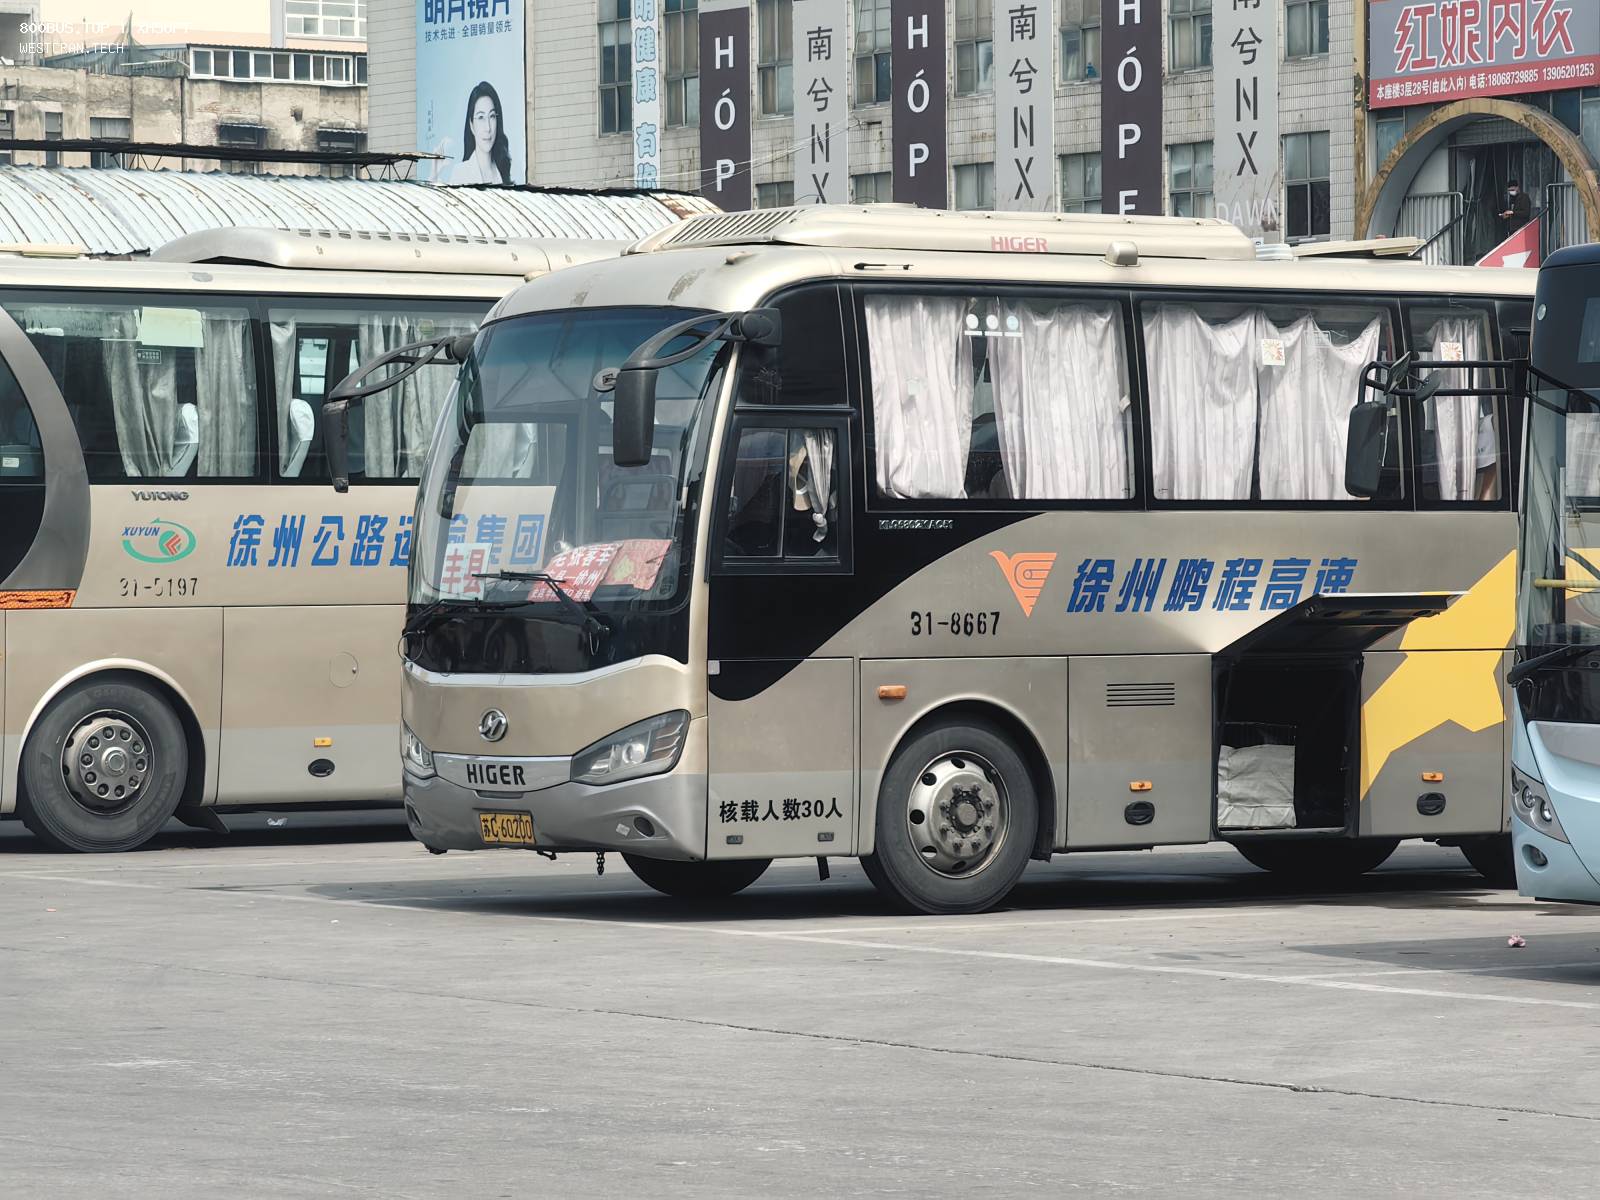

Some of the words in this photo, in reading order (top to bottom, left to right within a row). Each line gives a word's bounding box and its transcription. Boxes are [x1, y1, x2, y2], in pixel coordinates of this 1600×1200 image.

[990, 236, 1049, 252] HIGER
[131, 490, 190, 501] YUTONG
[121, 526, 161, 537] XUYUN
[120, 576, 199, 597] 31-5197
[1066, 557, 1359, 613] 徐州鹏程高速
[910, 610, 1001, 637] 31-8667
[466, 763, 527, 786] HIGER
[719, 797, 843, 823] 核载人数30人
